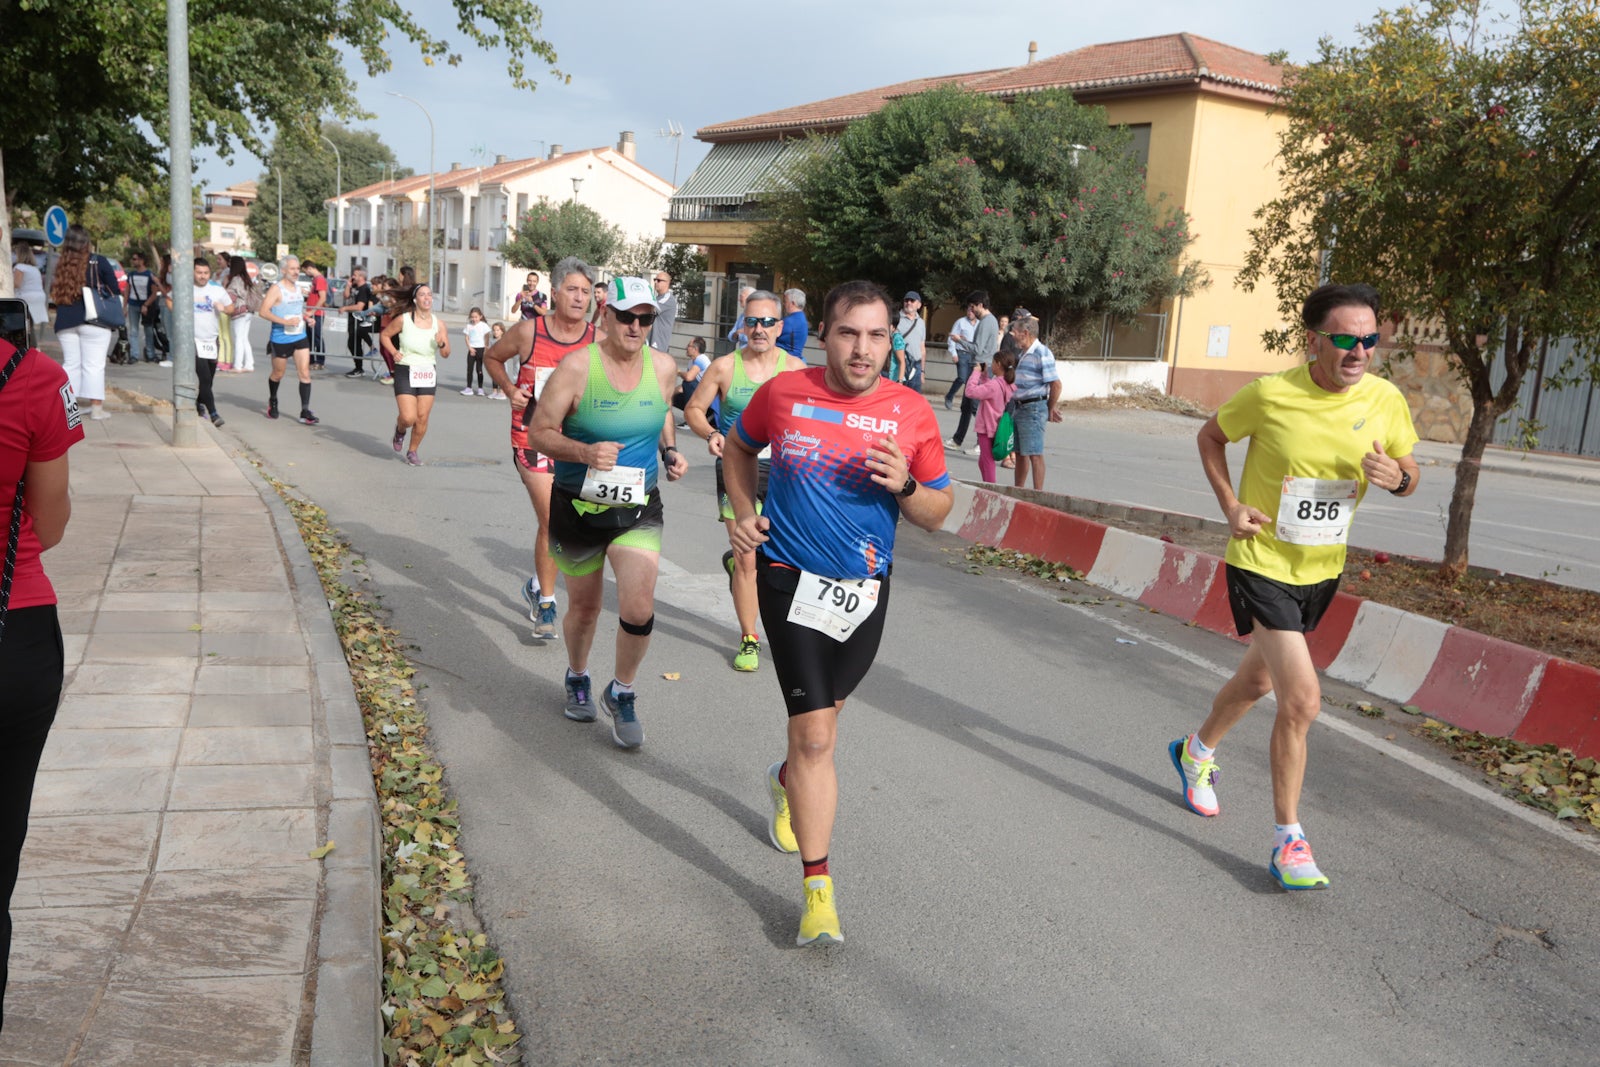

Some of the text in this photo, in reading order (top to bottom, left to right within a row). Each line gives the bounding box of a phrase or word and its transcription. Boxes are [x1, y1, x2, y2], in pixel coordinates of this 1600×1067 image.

[845, 413, 899, 435] SEUR
[595, 484, 632, 503] 315
[1297, 500, 1340, 521] 856
[817, 578, 860, 614] 790
